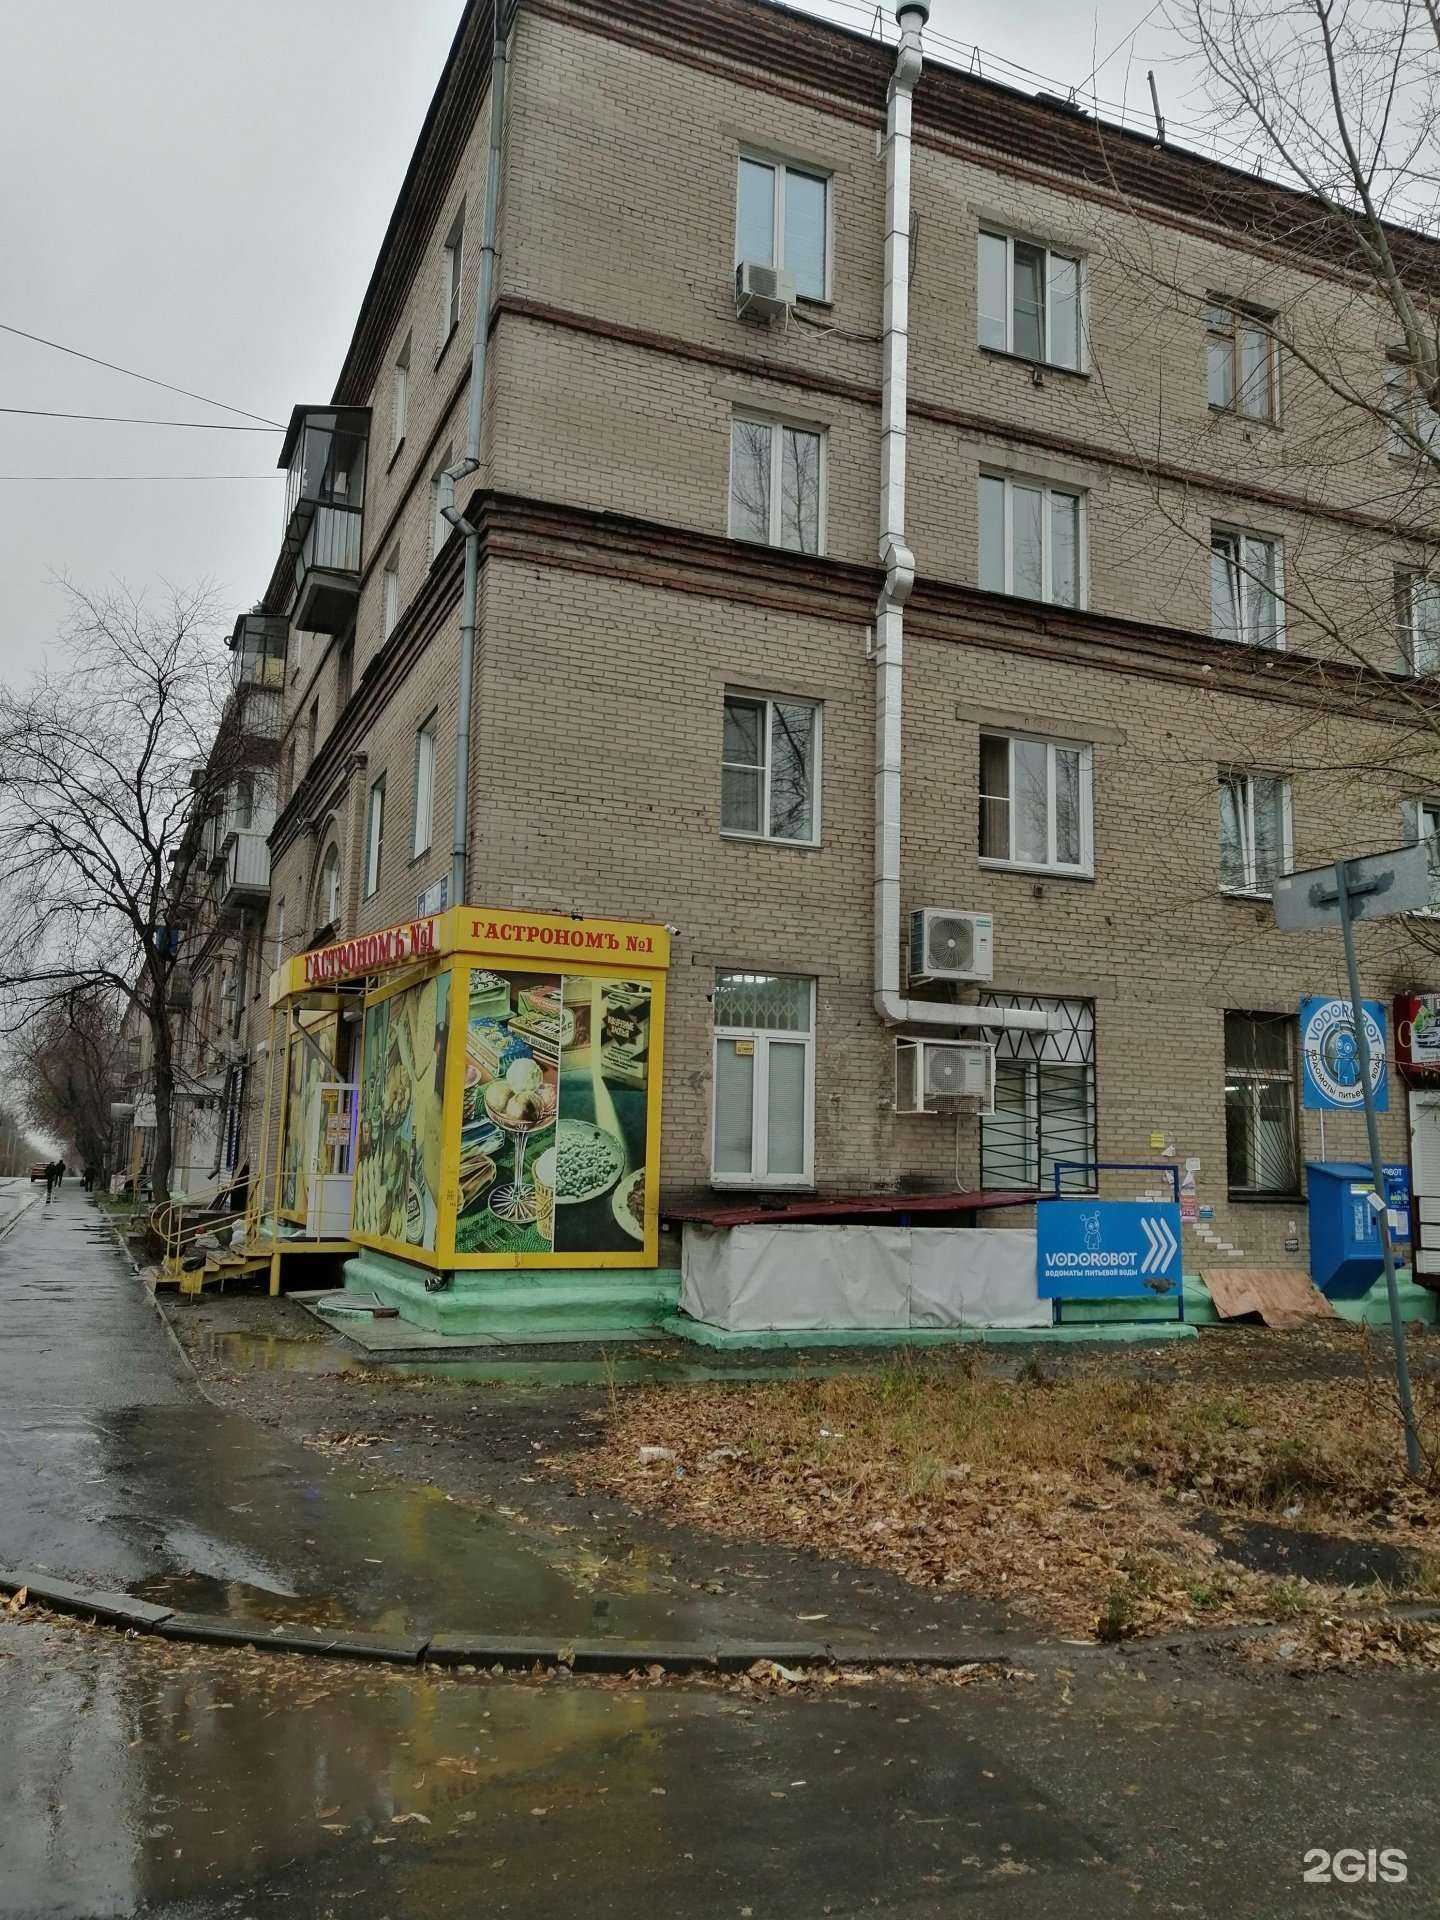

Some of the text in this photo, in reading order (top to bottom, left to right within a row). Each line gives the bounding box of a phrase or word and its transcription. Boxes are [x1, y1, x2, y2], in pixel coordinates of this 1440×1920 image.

[471, 921, 654, 953] ГАСТРОНОМЪ №1
[304, 928, 405, 984] ГАСТРОНОМЪ
[1045, 1252, 1138, 1267] VODOROBOT
